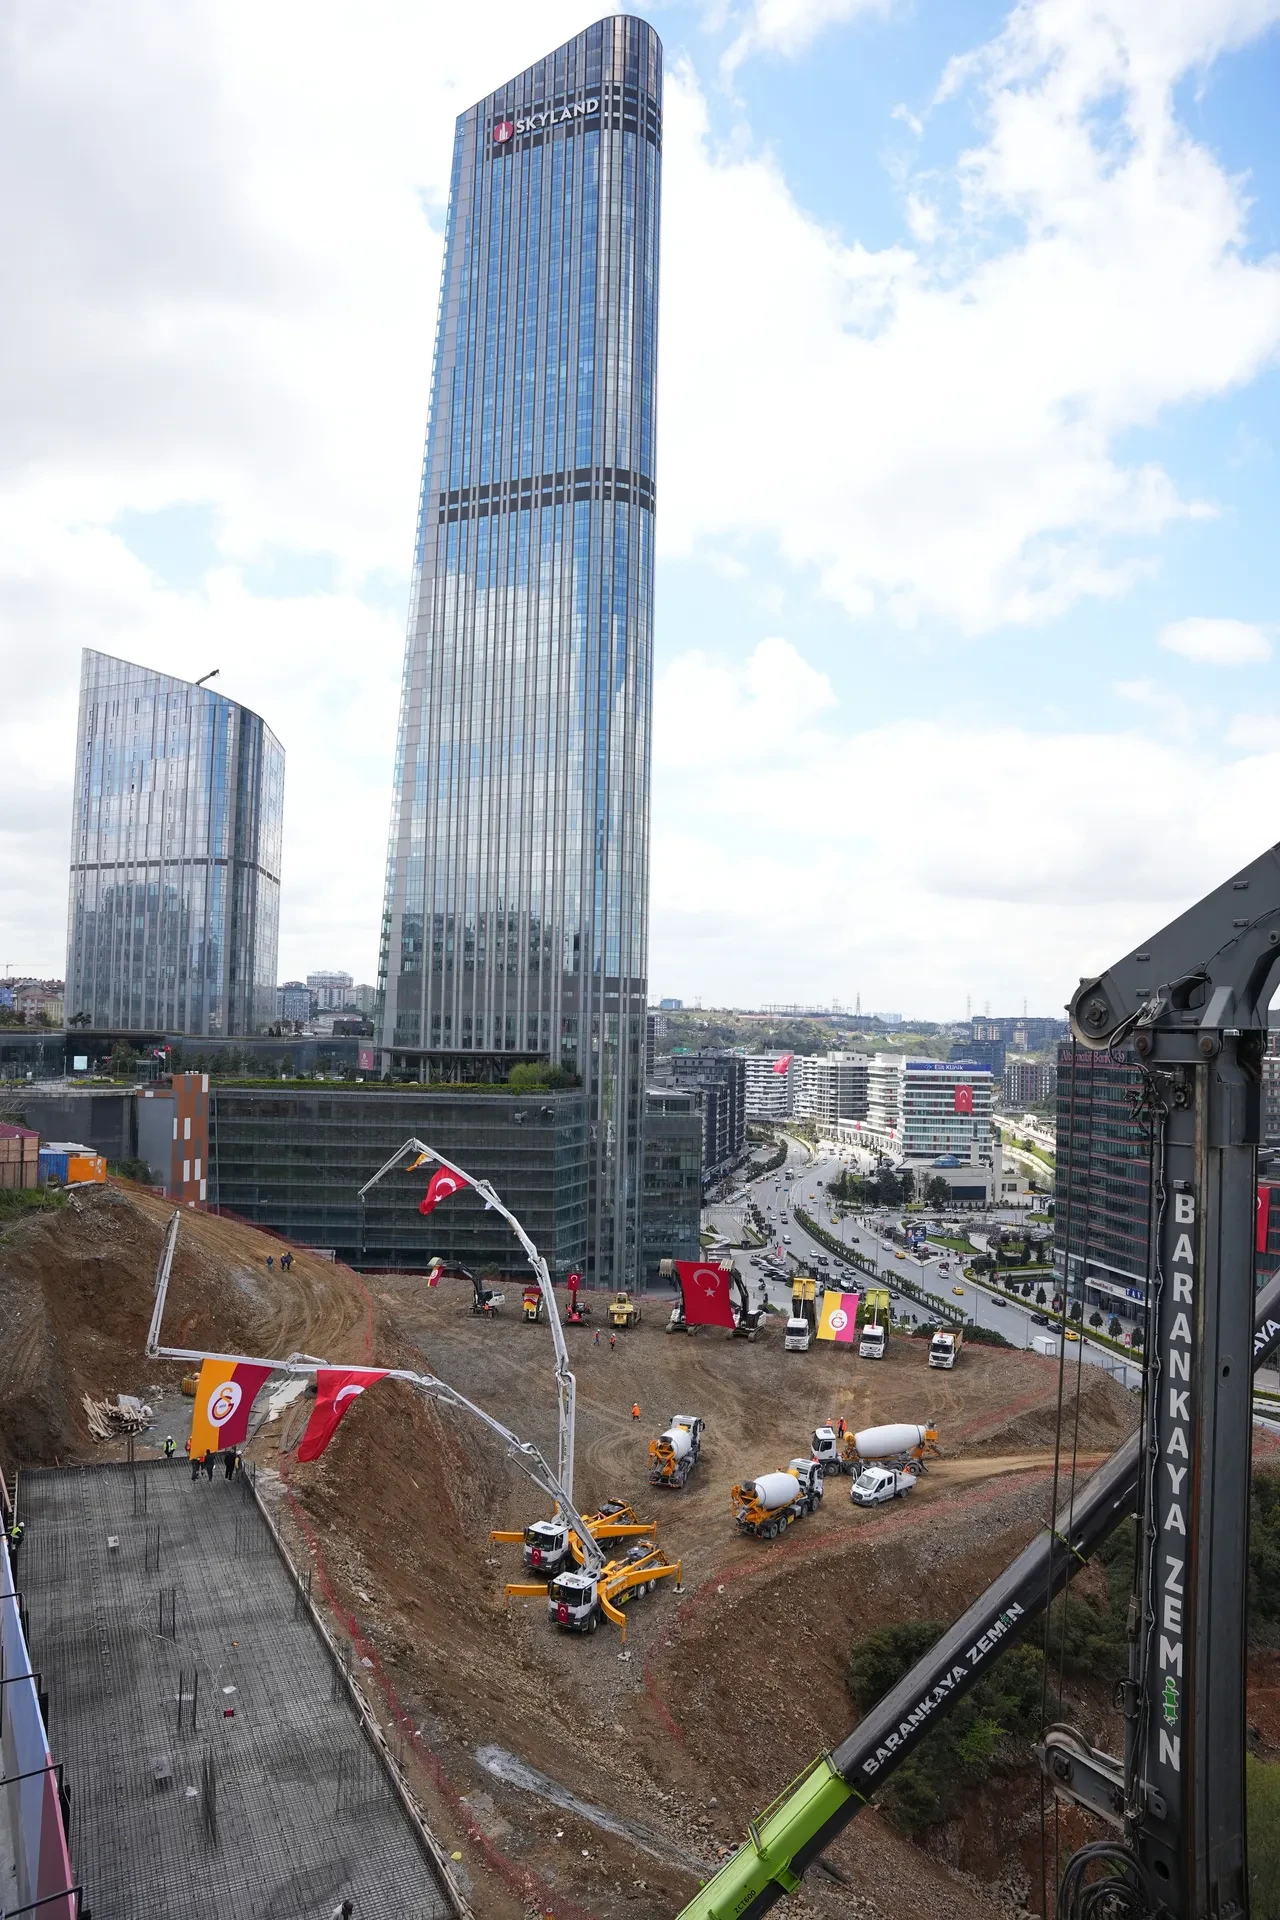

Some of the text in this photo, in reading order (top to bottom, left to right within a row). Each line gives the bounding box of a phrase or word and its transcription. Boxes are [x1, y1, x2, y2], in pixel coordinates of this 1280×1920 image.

[516, 98, 599, 134] SKYLAND
[1164, 1193, 1195, 1536] BARANKAYA
[861, 1665, 969, 1775] BARANKAYA
[734, 1889, 757, 1914] ZCT600
